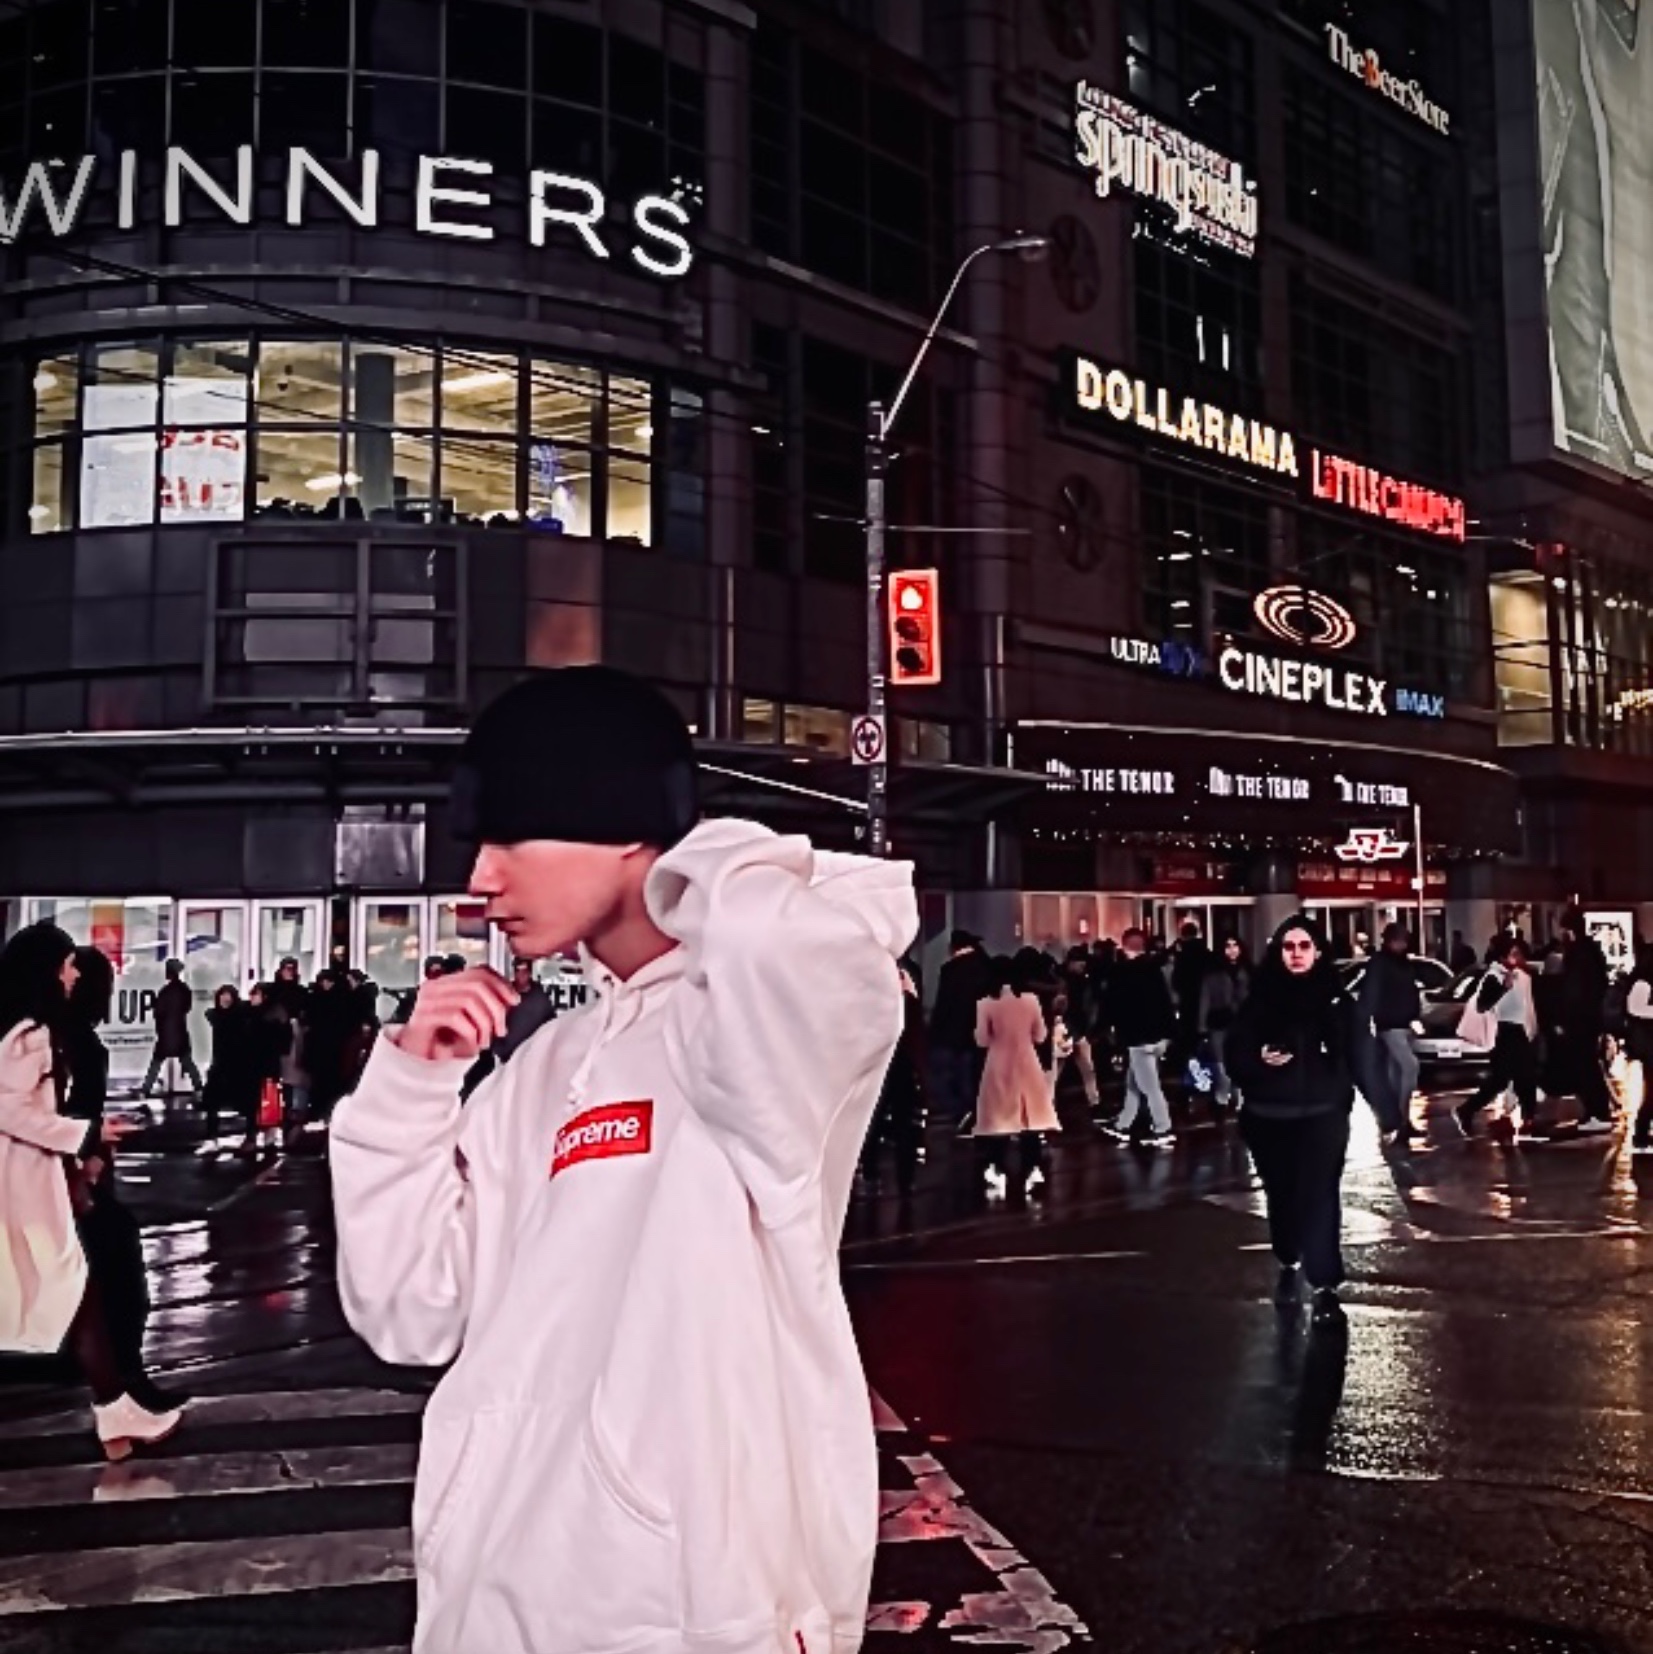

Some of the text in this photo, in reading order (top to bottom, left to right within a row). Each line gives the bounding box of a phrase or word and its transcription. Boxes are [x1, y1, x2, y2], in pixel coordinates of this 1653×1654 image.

[1324, 22, 1365, 78] The
[0, 144, 693, 277] WINNERS
[1077, 356, 1299, 478] DOLLARAMA
[1110, 636, 1162, 665] ULTRA
[1219, 647, 1388, 716] CINEPLEX
[1395, 688, 1446, 718] IMAX
[1080, 769, 1115, 792] THE
[1235, 774, 1310, 800] THE TENOR
[118, 988, 158, 1025] UP
